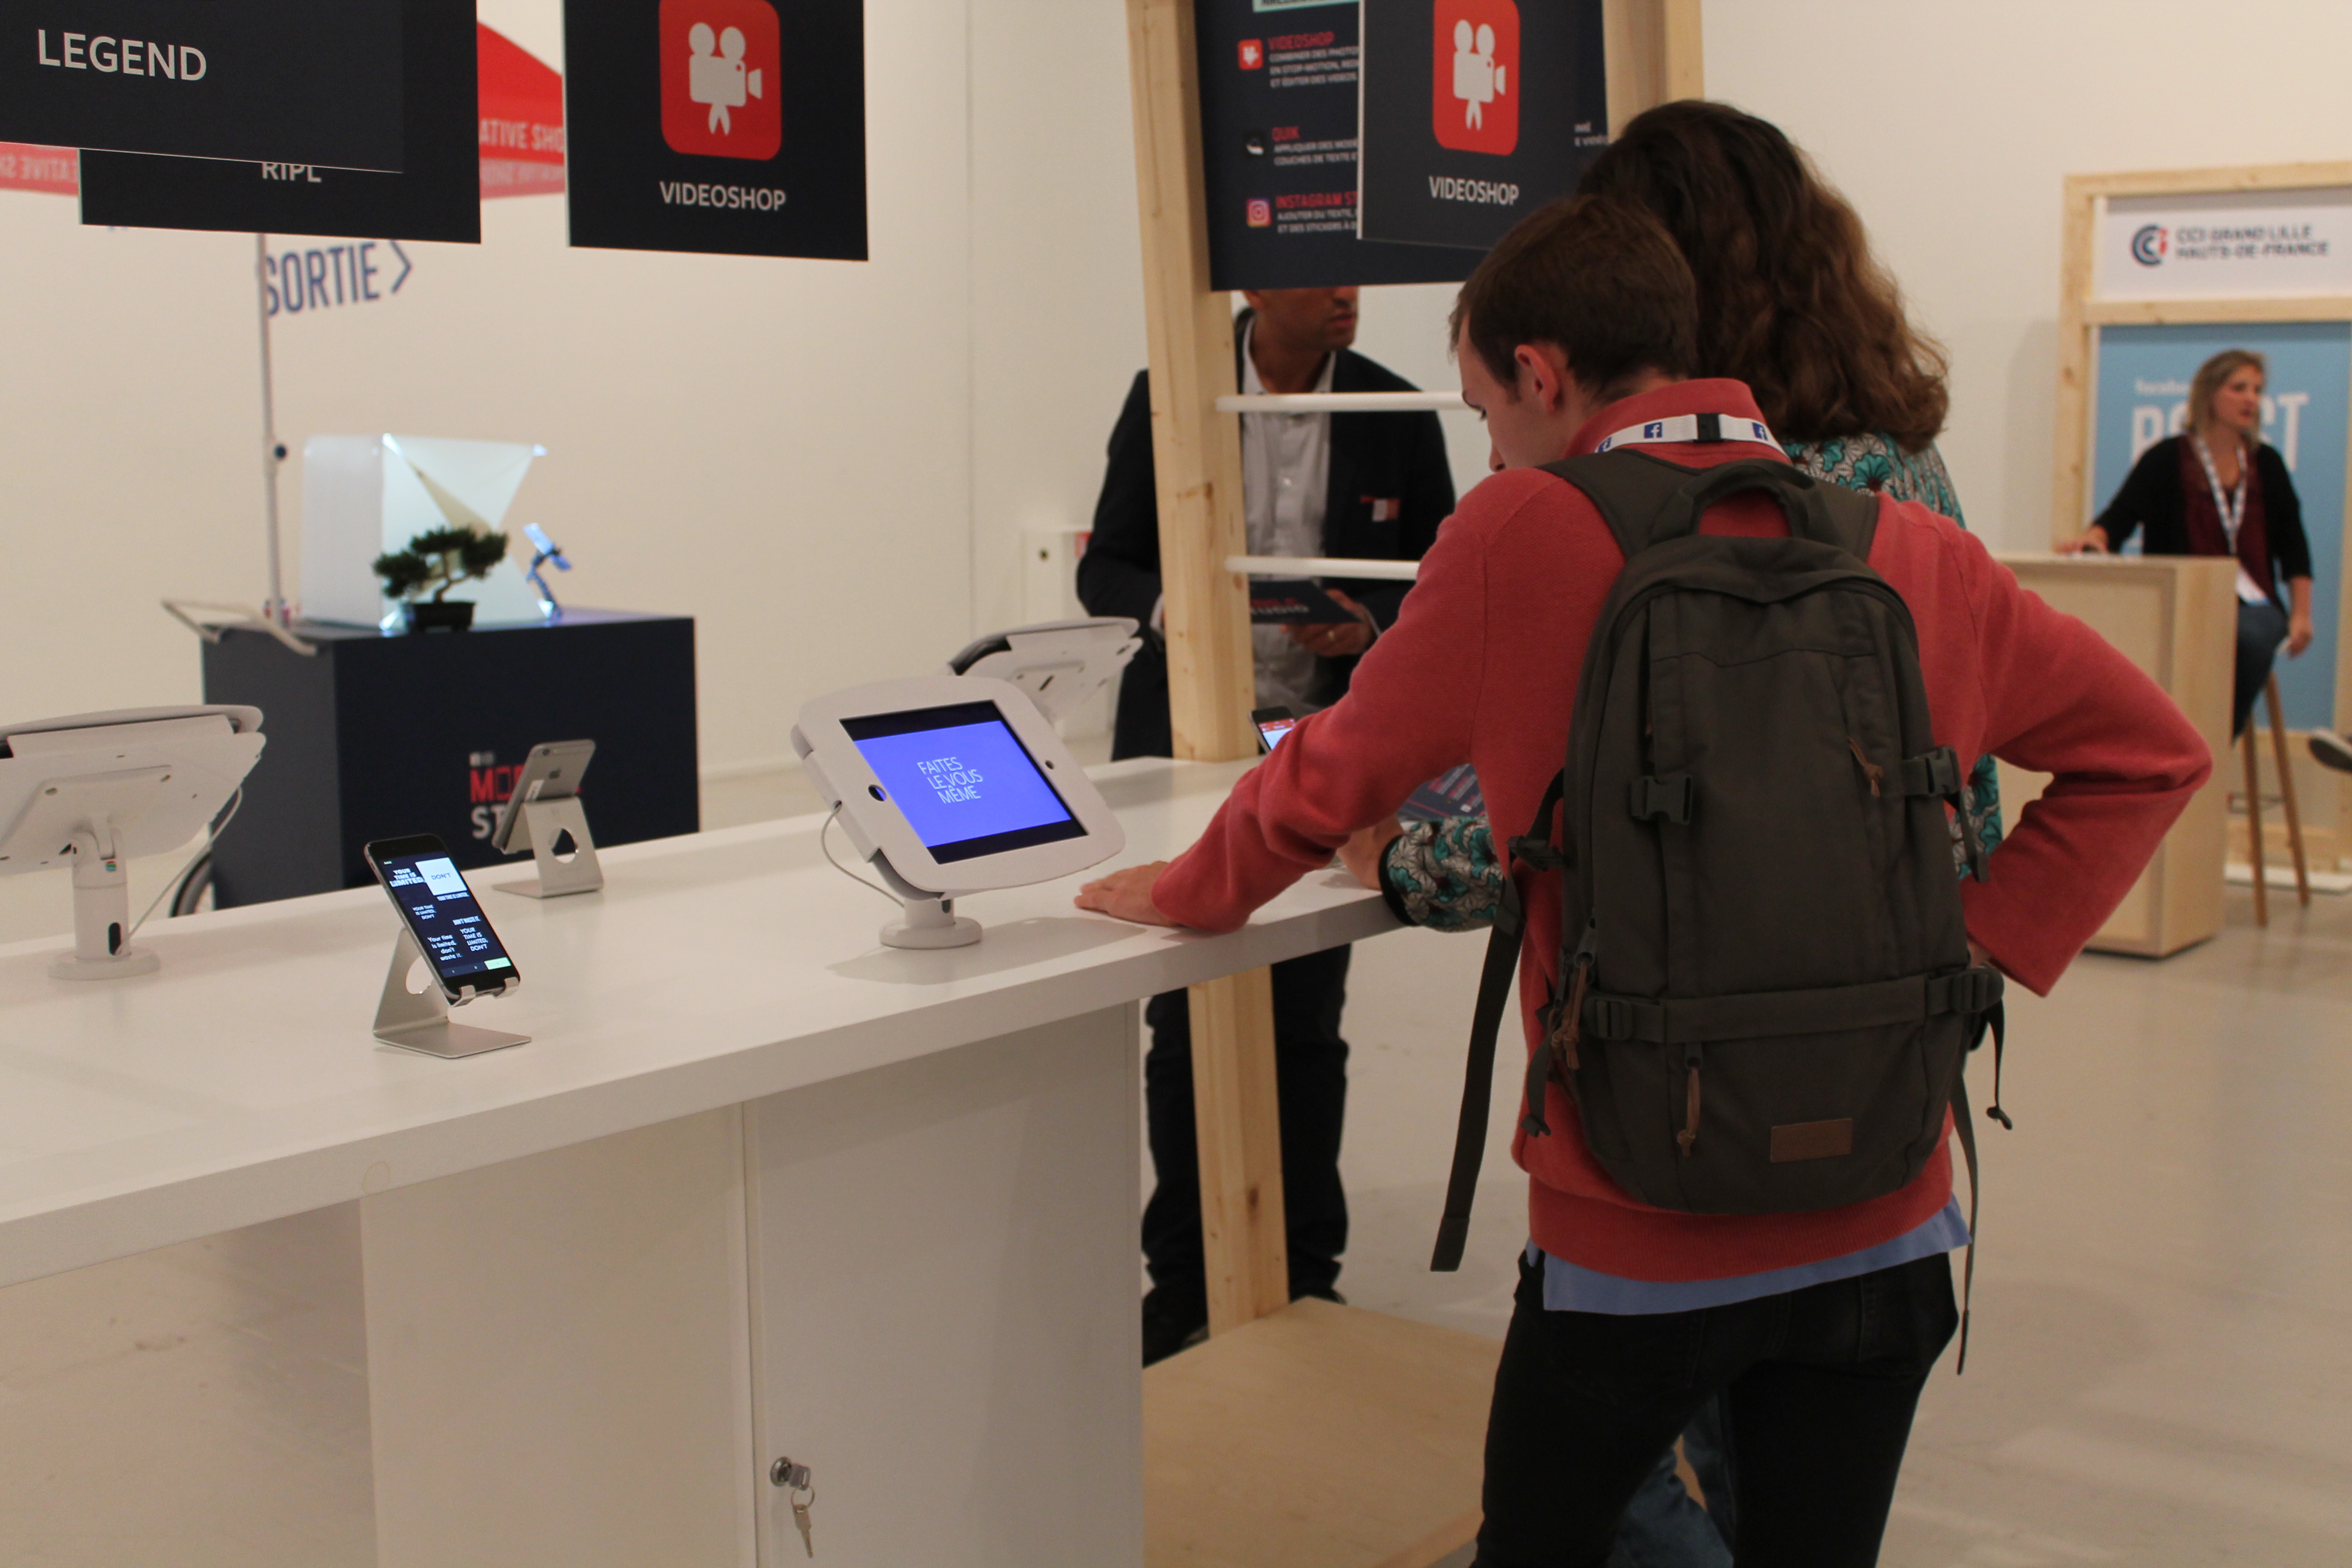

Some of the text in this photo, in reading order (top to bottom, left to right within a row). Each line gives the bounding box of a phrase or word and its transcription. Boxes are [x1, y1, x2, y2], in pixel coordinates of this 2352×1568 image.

[37, 29, 206, 81] LEGEND
[660, 181, 786, 211] VIDEOSHOP
[1429, 175, 1520, 206] VIDEOSHOP
[917, 757, 963, 775] FAITES
[927, 769, 983, 790] LE VOUS
[937, 785, 981, 804] MÊME
